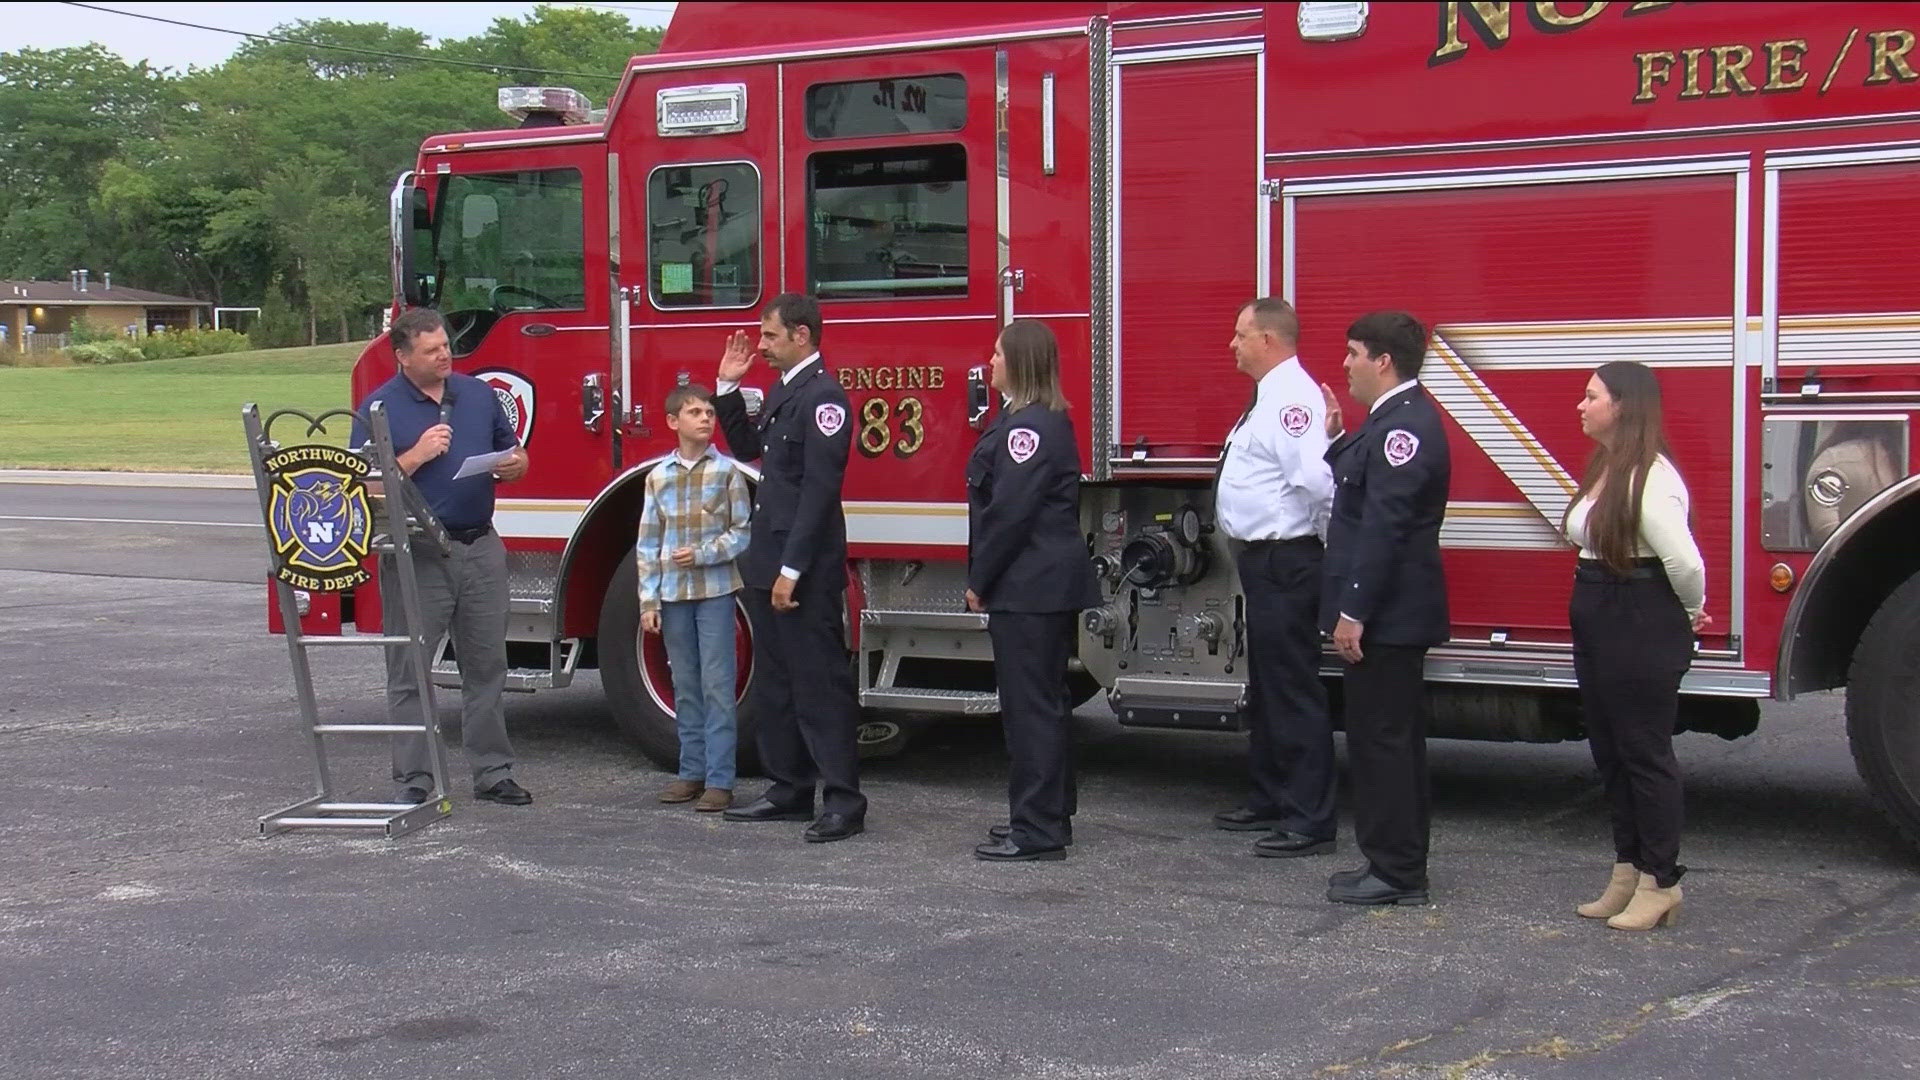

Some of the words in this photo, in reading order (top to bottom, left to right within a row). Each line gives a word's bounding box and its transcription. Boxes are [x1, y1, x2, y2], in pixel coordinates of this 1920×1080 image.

[837, 366, 945, 391] ENGINE
[860, 397, 925, 453] 83
[266, 448, 368, 474] NORTHWOOD
[307, 521, 334, 543] N
[279, 568, 320, 591] FIRE
[323, 570, 371, 592] DEPT.
